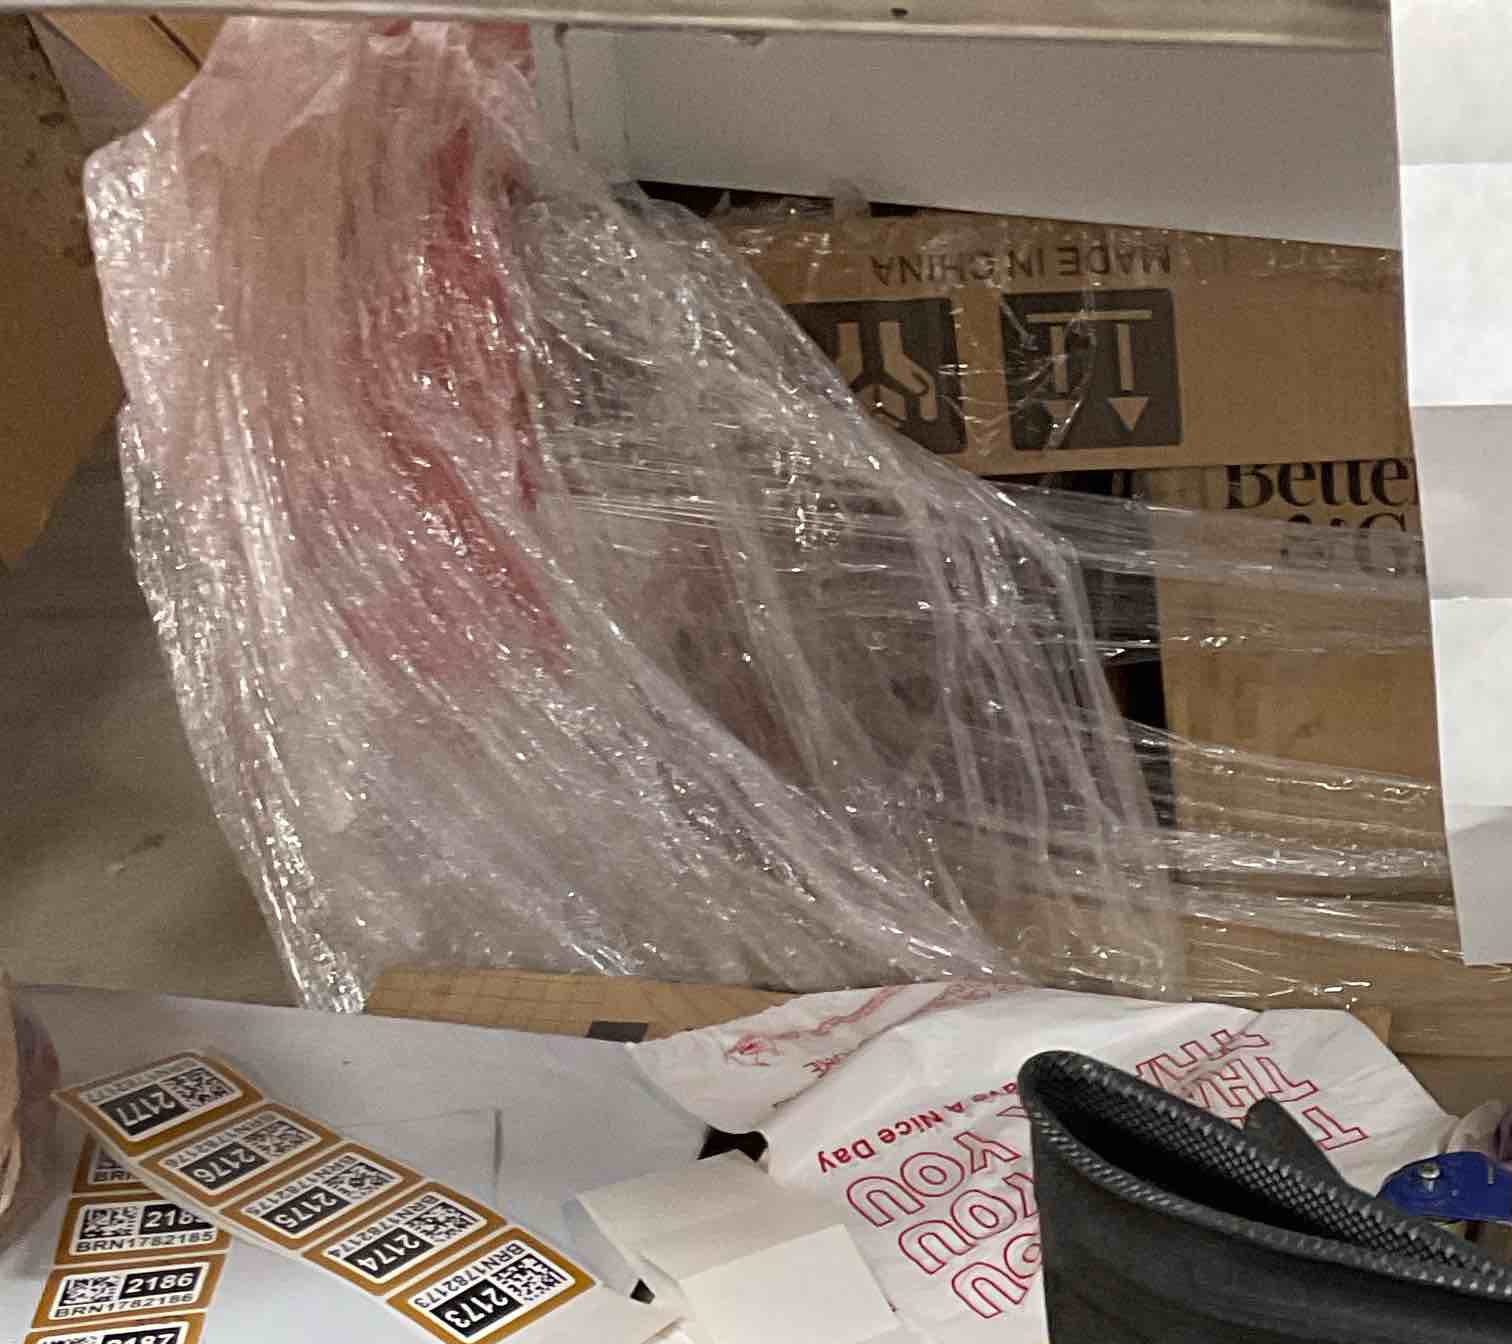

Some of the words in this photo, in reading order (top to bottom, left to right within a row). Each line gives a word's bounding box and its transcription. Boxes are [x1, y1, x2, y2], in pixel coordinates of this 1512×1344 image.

[870, 252, 998, 287] CHINA
[1006, 249, 1045, 278] IN
[1057, 246, 1172, 277] MADE
[115, 1088, 178, 1127] 2177
[876, 1110, 944, 1145] Nice
[192, 1145, 257, 1184] 2176
[817, 1138, 877, 1174] Day
[245, 1154, 358, 1215] BRN1782175
[846, 1130, 1022, 1229] YOU
[273, 1190, 340, 1229] 2175
[327, 1194, 440, 1258] BRN1782174
[74, 1229, 213, 1254] BRN1782185
[356, 1231, 422, 1272] 2174
[125, 1272, 195, 1295] 2186
[412, 1242, 526, 1308] BRN1782173
[52, 1292, 194, 1319] BRN1782186
[443, 1286, 509, 1329] 2173
